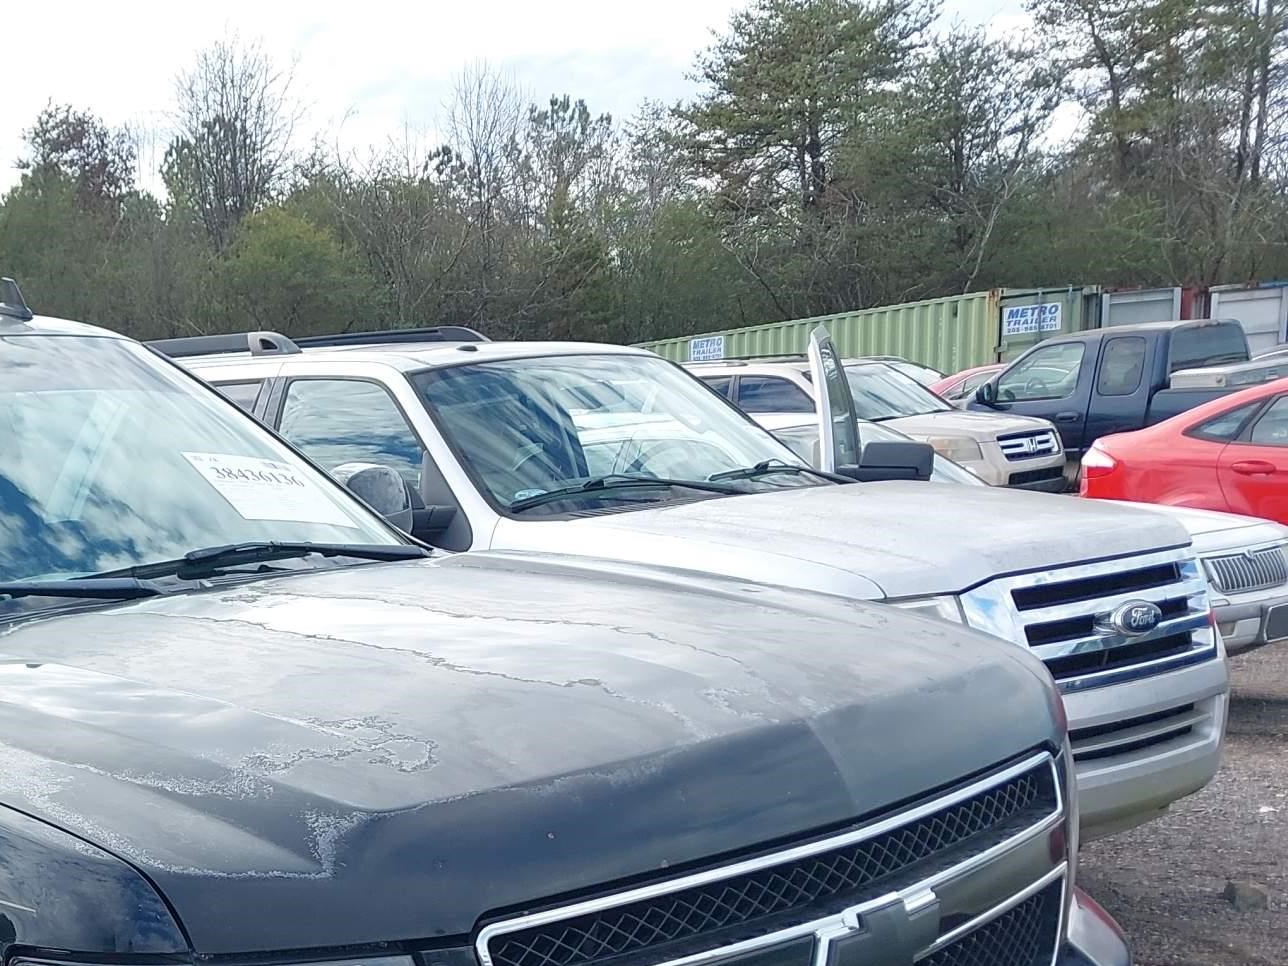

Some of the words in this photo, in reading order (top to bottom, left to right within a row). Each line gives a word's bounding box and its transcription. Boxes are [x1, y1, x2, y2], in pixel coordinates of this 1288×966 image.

[1007, 304, 1059, 319] METRO
[1006, 315, 1057, 327] TRAILER
[692, 337, 722, 349] METRO
[210, 466, 305, 487] 38436136
[1131, 607, 1155, 627] Ford
